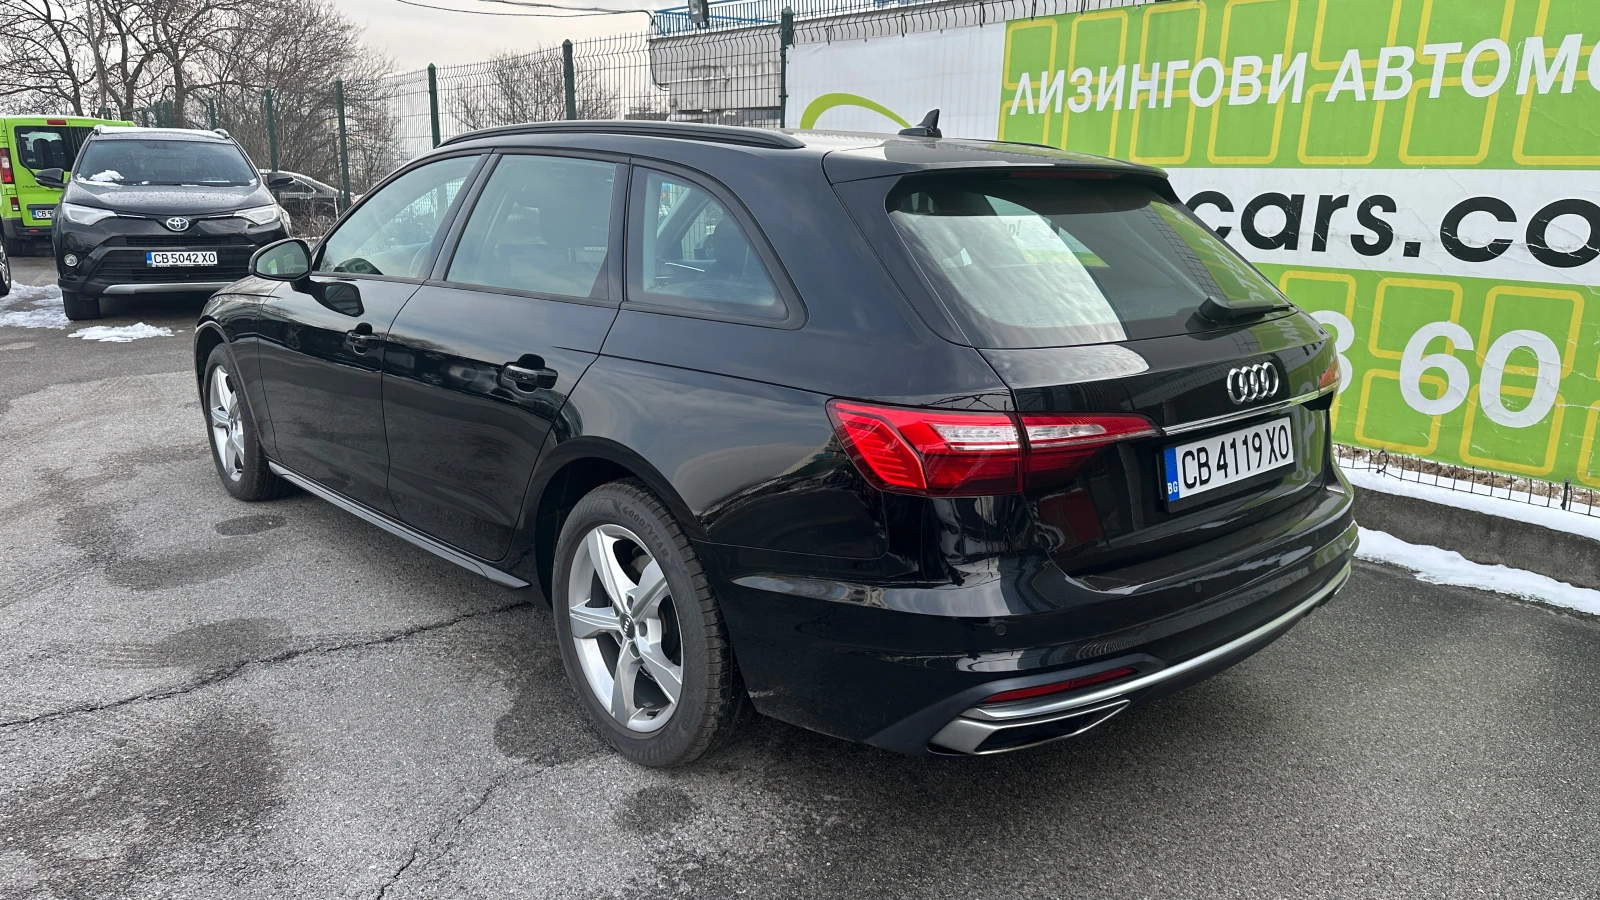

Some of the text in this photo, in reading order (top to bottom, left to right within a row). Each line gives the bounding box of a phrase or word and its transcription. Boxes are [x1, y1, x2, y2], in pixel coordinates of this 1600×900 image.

[1009, 33, 1600, 116] ЛИЗИНГОВИ АВТОМ
[170, 252, 200, 264] 5042
[1216, 431, 1263, 479] 4119
[1167, 481, 1178, 495] BG
[622, 505, 669, 557] GOODYEAR
